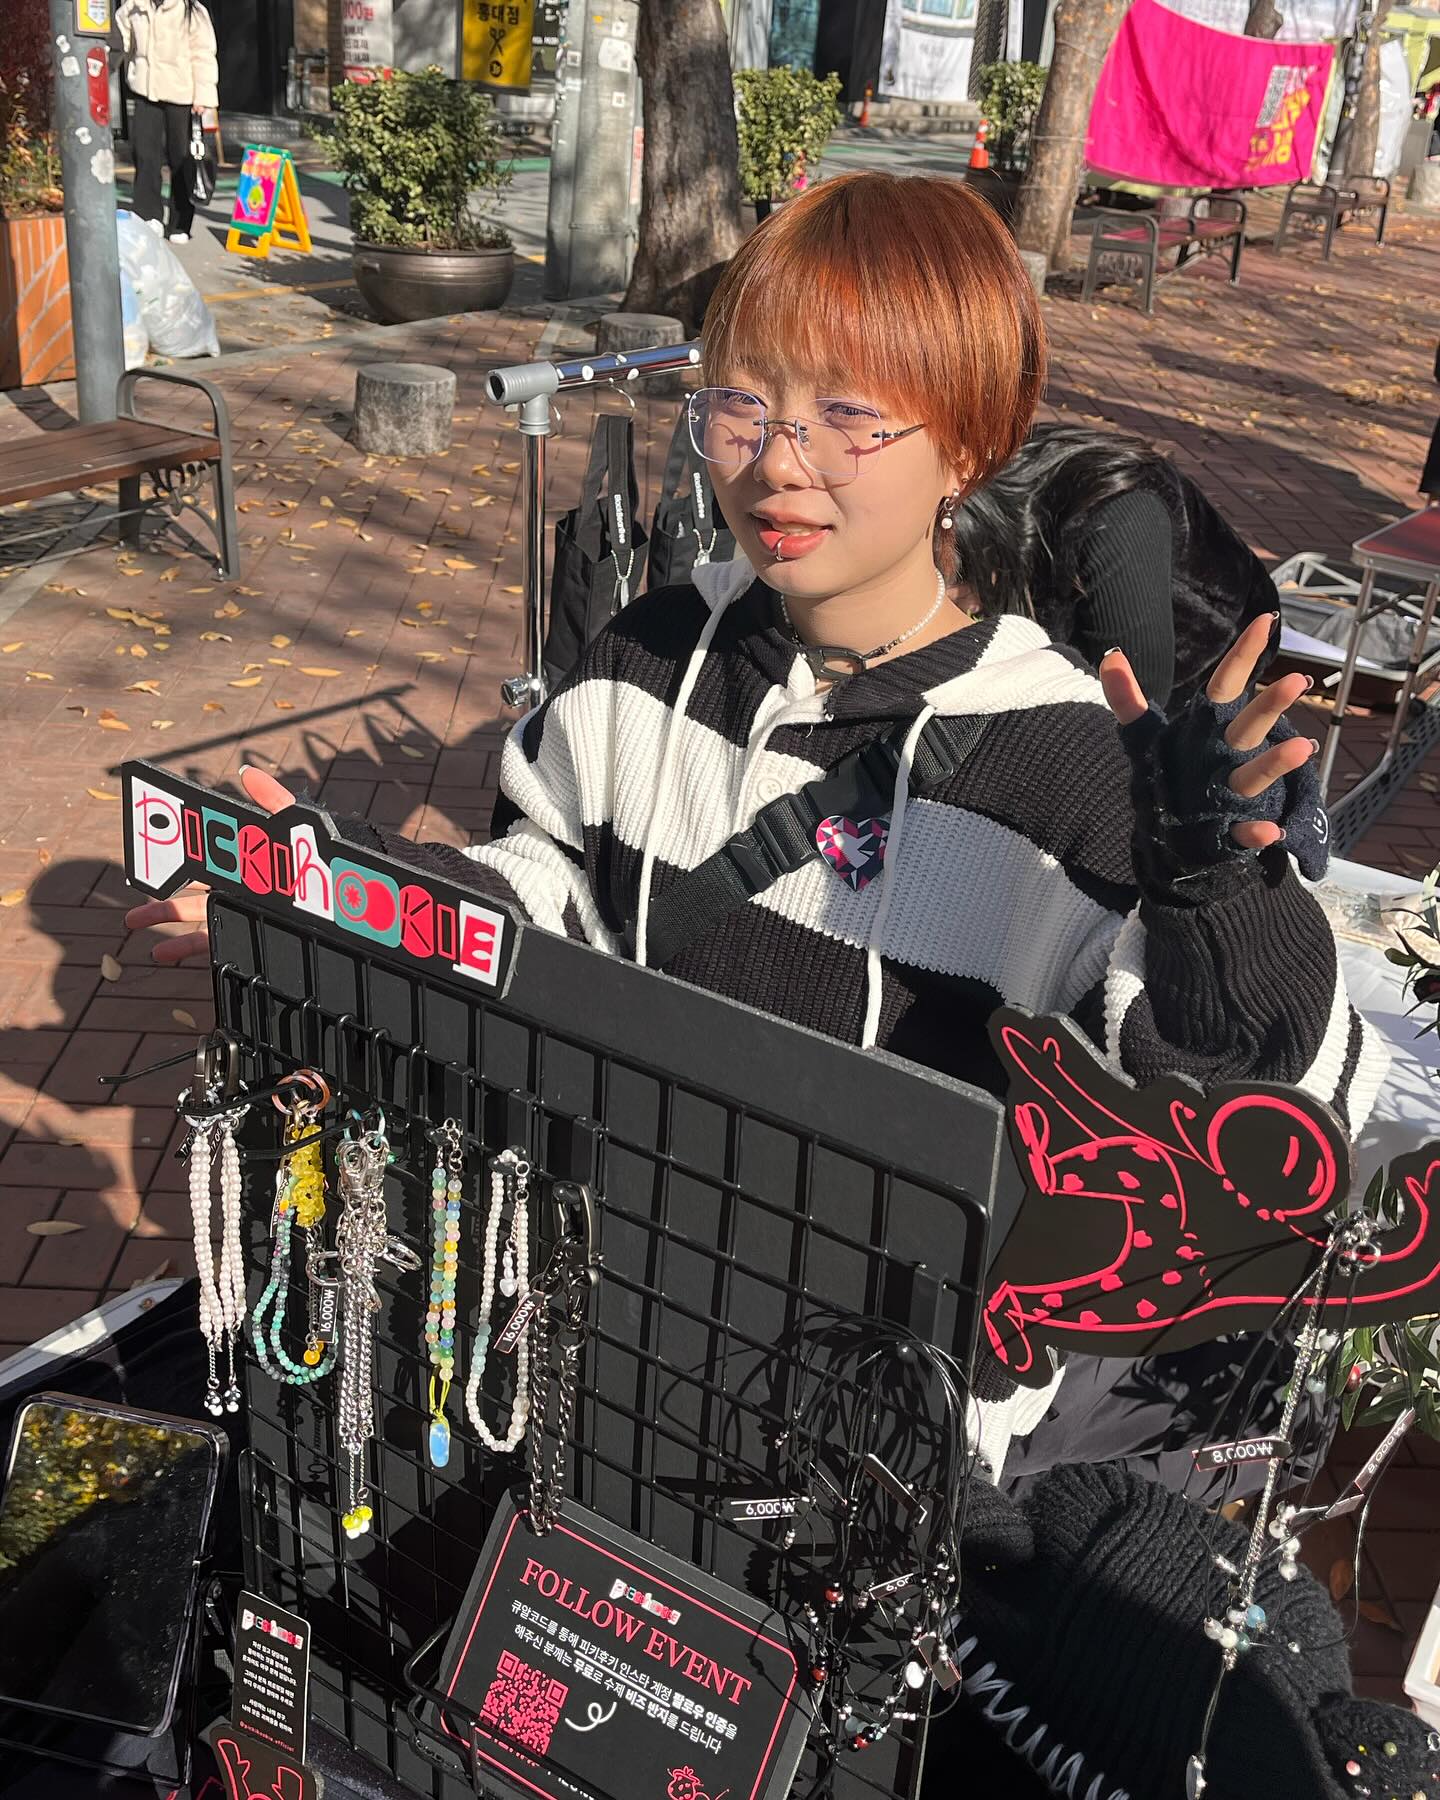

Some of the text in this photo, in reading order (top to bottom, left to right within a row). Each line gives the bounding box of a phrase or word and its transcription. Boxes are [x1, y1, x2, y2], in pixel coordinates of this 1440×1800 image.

[512, 1600, 737, 1740] 큐알코드를 통해 피키후키 인스타 계정 팔로우 인증을
[515, 1624, 721, 1754] 해주신 분께는 무료로 수제 비즈 반지를 드립니다
[520, 1558, 751, 1704] FOLLOW EVENT
